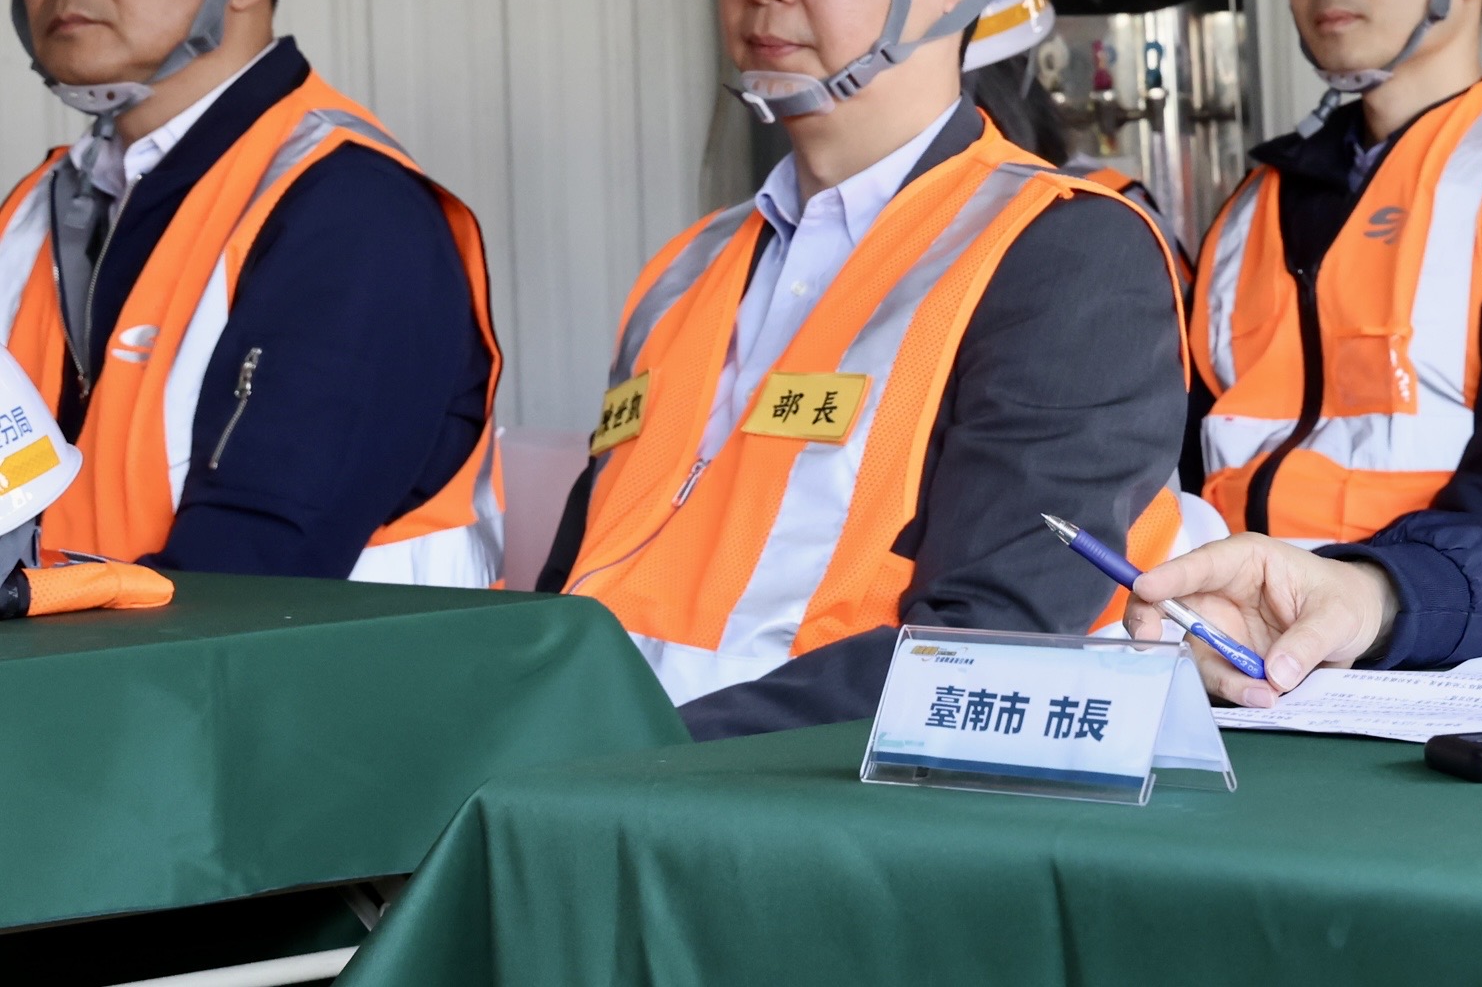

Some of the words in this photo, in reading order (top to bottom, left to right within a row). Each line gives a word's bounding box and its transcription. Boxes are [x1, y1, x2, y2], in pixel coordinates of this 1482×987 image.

[772, 389, 839, 425] 部長
[925, 685, 1031, 736] 臺南市
[1043, 695, 1113, 743] 市長
